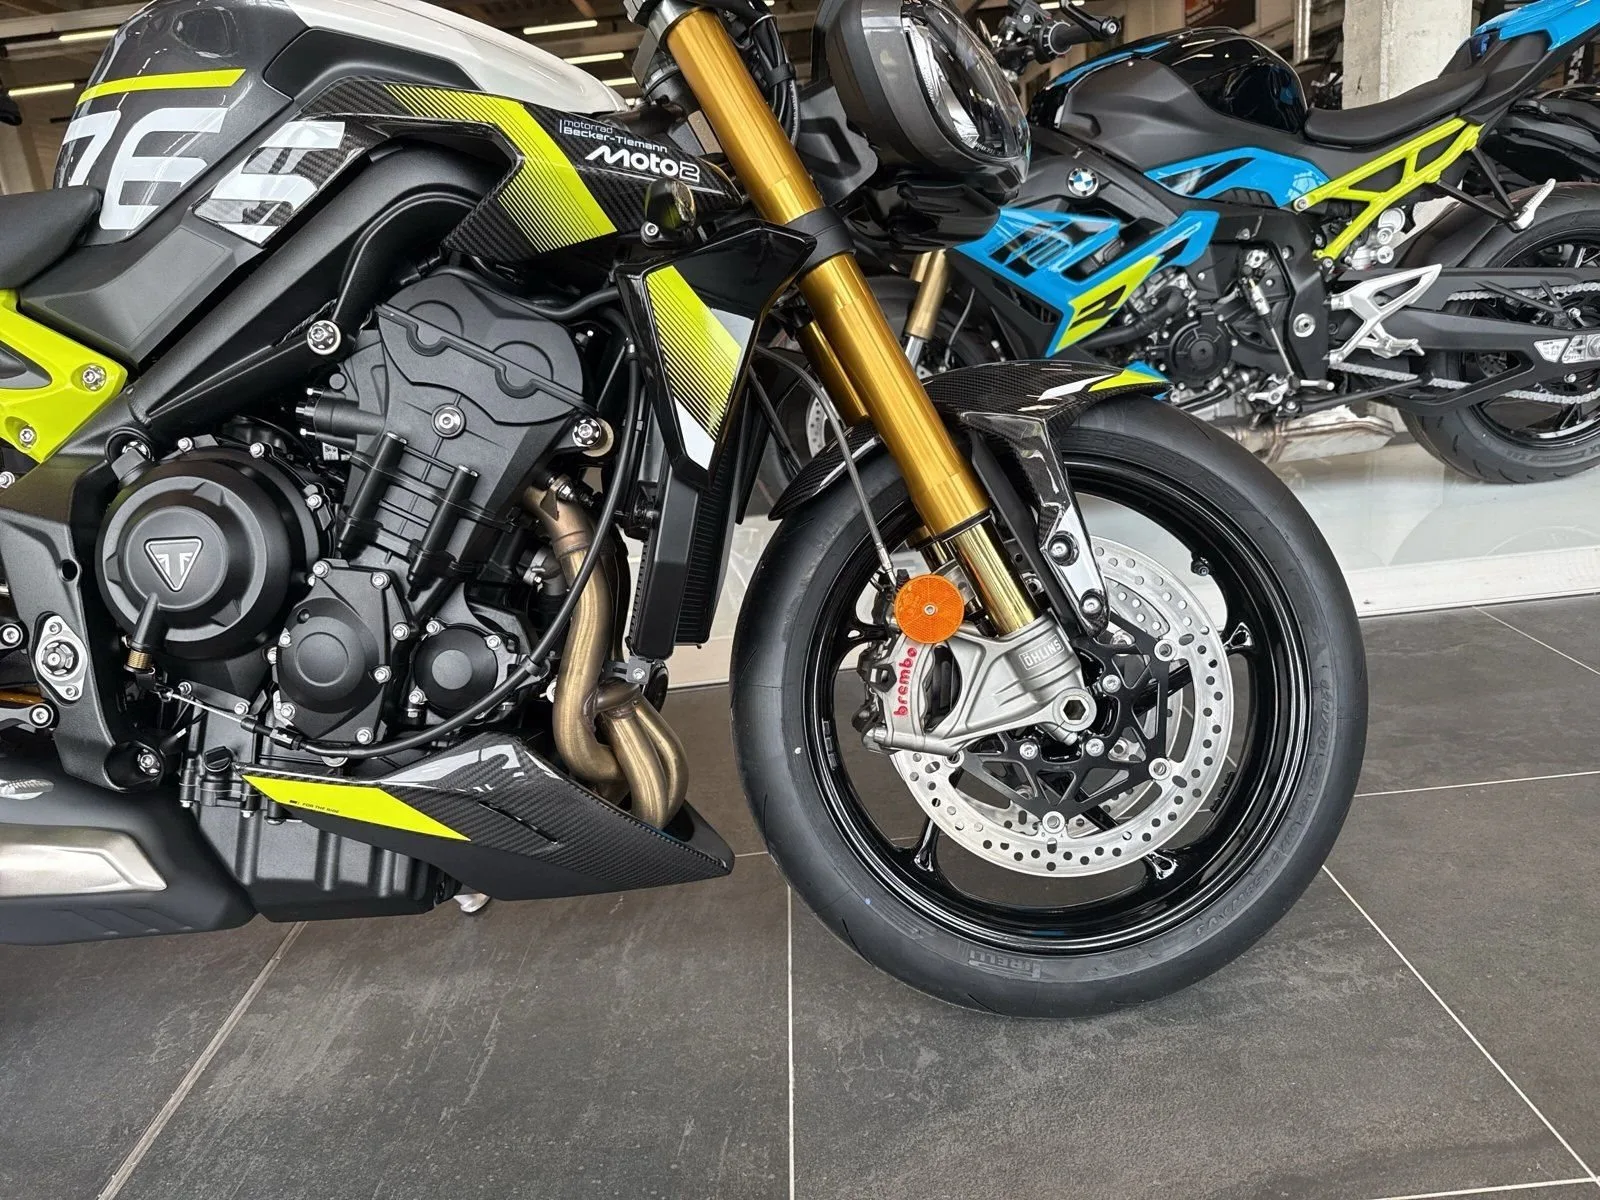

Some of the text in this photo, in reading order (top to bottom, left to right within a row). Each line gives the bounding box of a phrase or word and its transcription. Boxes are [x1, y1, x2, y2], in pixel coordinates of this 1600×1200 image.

[564, 120, 613, 134] motorrad
[564, 126, 668, 153] Becker-Tiemann
[585, 144, 700, 183] Moto2
[1023, 638, 1062, 667] ÖHLINS
[894, 647, 917, 716] brembo
